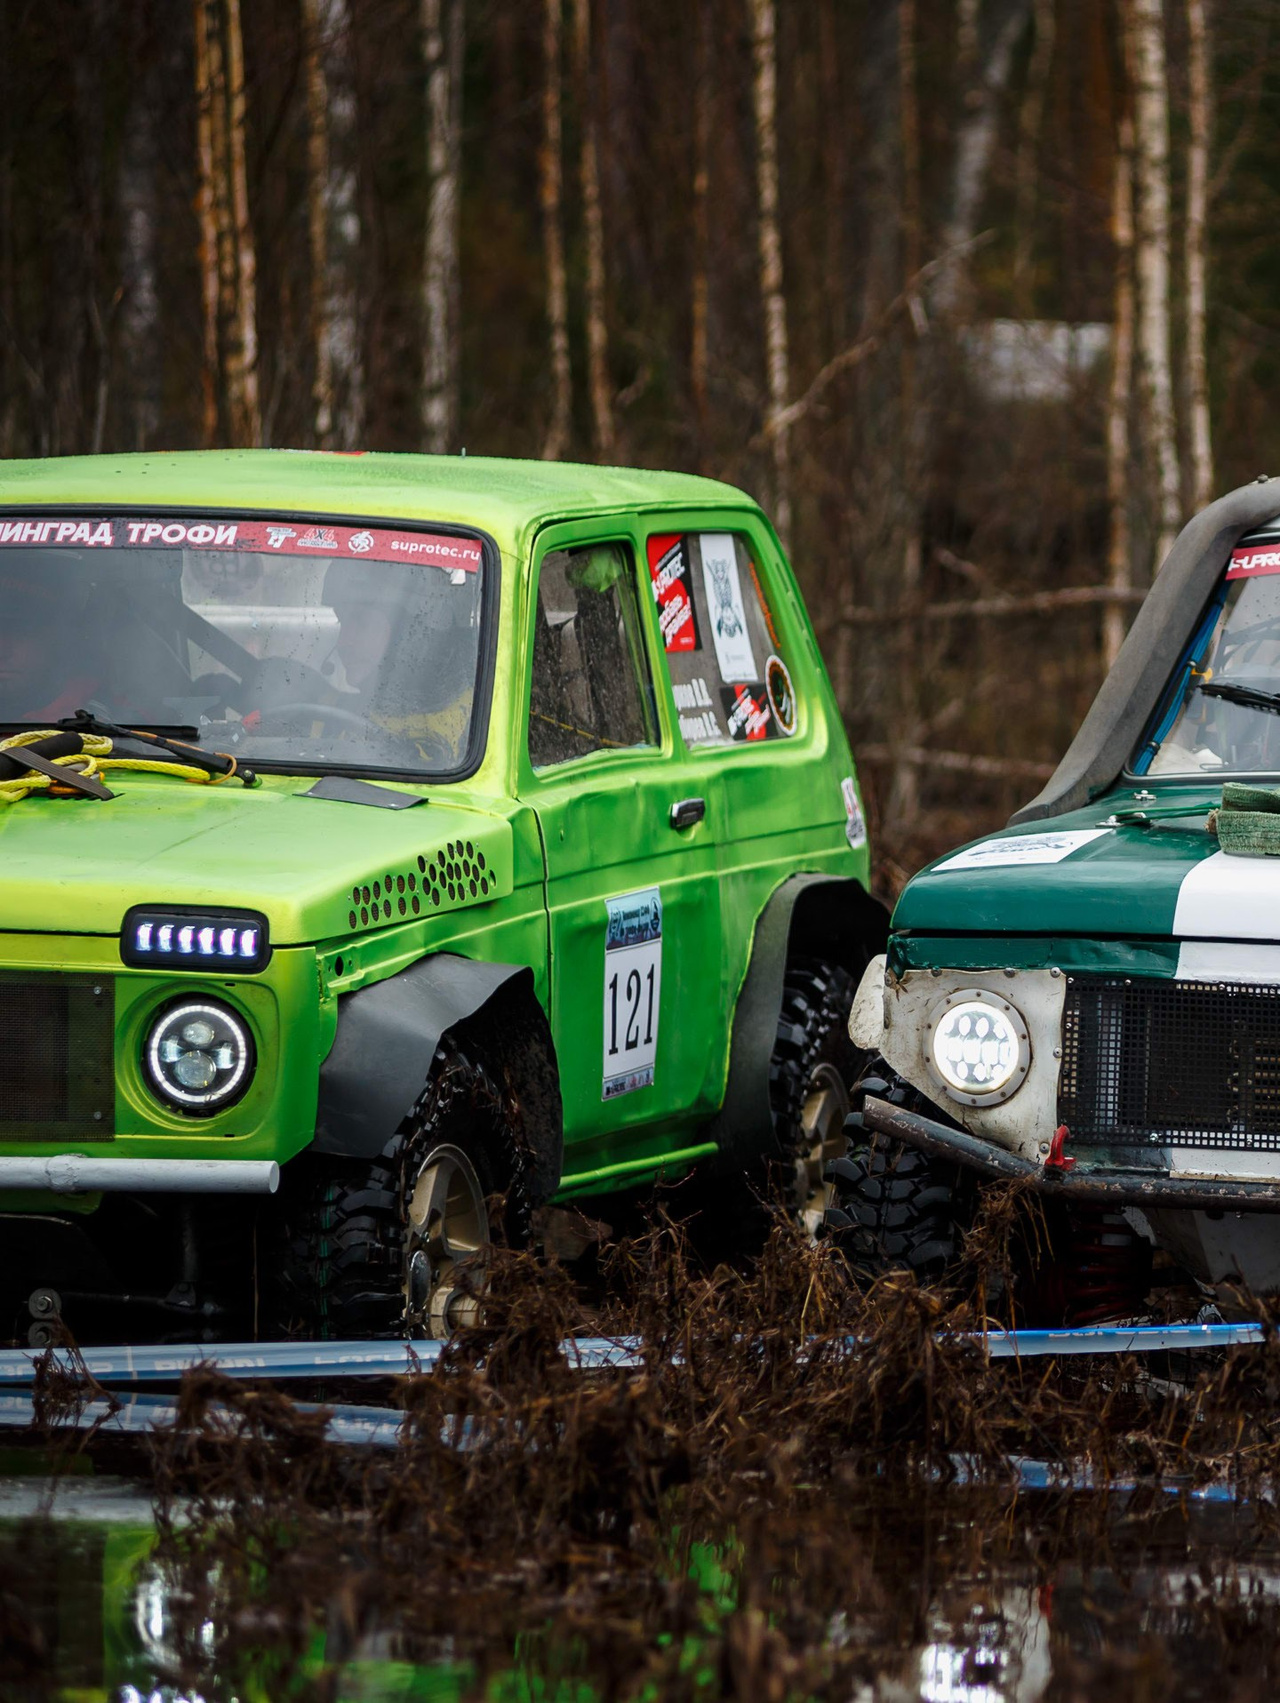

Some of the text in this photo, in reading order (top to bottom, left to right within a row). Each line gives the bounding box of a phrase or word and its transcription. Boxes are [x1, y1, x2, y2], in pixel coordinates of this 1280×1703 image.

[0, 521, 113, 546] ИНГРАД
[128, 522, 238, 545] ТРОФИ
[390, 539, 480, 561] suprotec.ru
[609, 963, 655, 1056] 121
